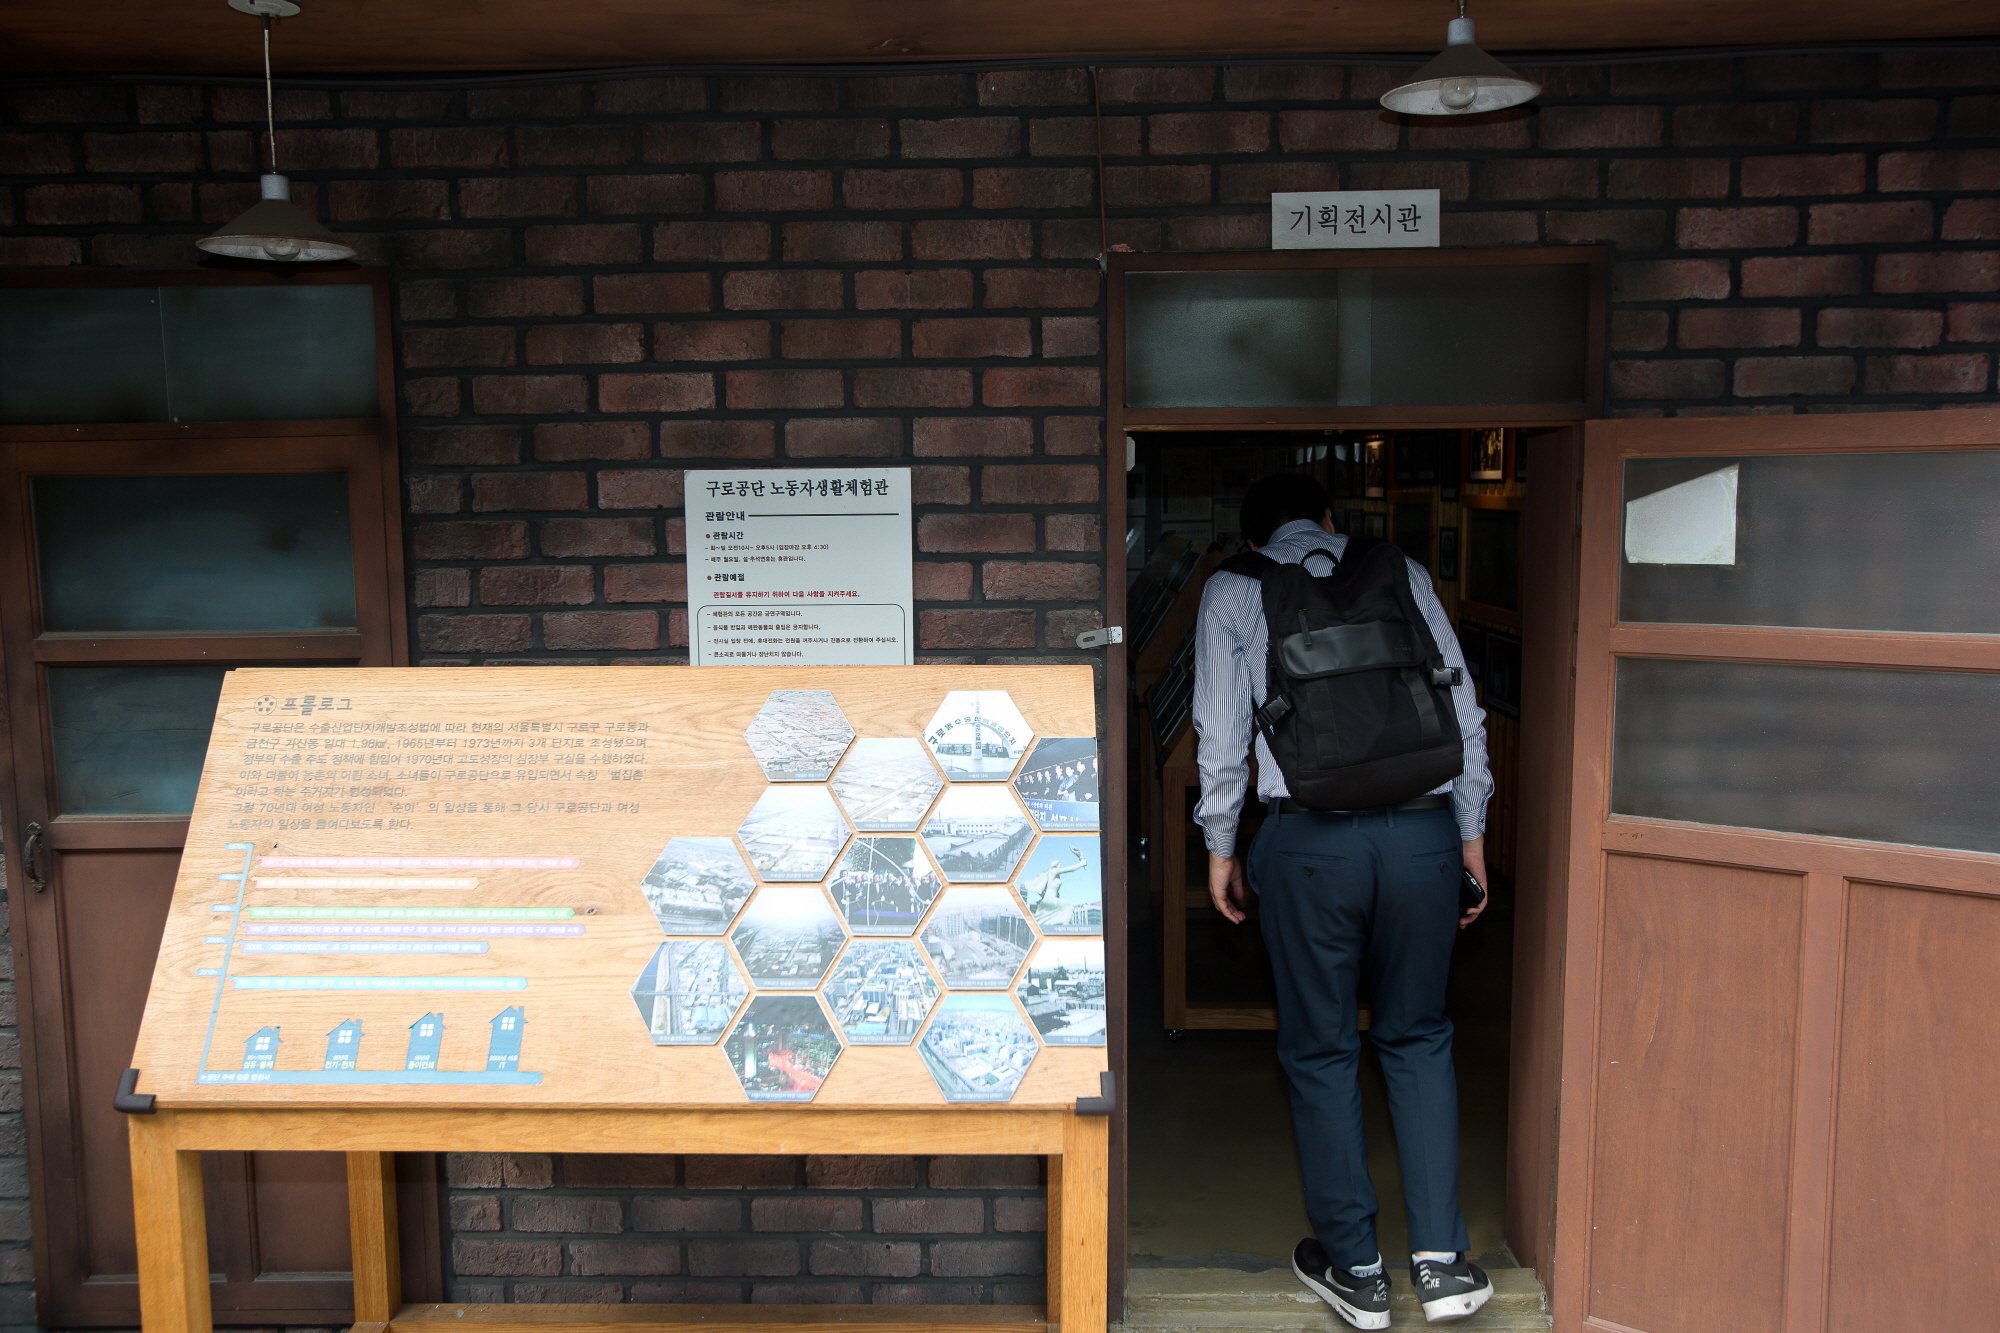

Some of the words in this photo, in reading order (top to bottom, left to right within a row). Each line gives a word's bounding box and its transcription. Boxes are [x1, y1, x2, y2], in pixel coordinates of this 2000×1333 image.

[1290, 204, 1422, 235] 기획전시관
[706, 480, 765, 497] 구로공단
[770, 478, 888, 497] 노동자생활체험관
[705, 511, 745, 521] 관람안내
[712, 532, 744, 540] 관람시간
[714, 573, 745, 581] 관람예절
[281, 695, 353, 716] 프롤로그
[250, 722, 305, 733] 구로공단은
[309, 722, 441, 733] 수출산업단지개발조성법에
[445, 722, 467, 733] 따라
[472, 722, 504, 733] 현재의
[508, 722, 563, 733] 서울특별시
[567, 722, 600, 733] 구로구
[604, 722, 649, 733] 구로동과
[246, 738, 281, 749] 금천구
[285, 738, 319, 749] 가산동
[324, 738, 346, 749] 일대
[397, 738, 457, 749] 1965년부터
[463, 738, 524, 749] 1973년까지
[529, 738, 547, 749] 3개
[552, 738, 585, 749] 단지로
[244, 754, 276, 765] 정부의
[280, 754, 302, 765] 수출
[306, 754, 327, 765] 주도
[332, 754, 364, 765] 정책에
[369, 754, 401, 765] 힘입어
[406, 754, 454, 765] 1970년대
[457, 754, 513, 765] 고도성장의
[516, 754, 549, 765] 심장부
[553, 754, 586, 765] 구실을
[590, 754, 648, 765] 수행하였다.
[240, 770, 262, 781] 이와
[266, 770, 299, 781] 더불어
[303, 770, 337, 781] 농촌의
[341, 770, 363, 781] 어린
[366, 770, 392, 781] 소녀,
[396, 770, 441, 781] 소녀들이
[445, 770, 512, 781] 구로공단으로
[516, 770, 572, 781] 유입되면서
[576, 770, 598, 781] 속칭
[274, 786, 296, 797] 하는
[300, 786, 345, 797] 주거지가
[349, 786, 408, 797] 형성되었다.
[260, 802, 297, 813] 70년대
[302, 802, 325, 813] 여성
[328, 802, 375, 813] 노동자인
[428, 802, 439, 813] 의
[444, 802, 478, 813] 일상을
[483, 802, 506, 813] 통해
[510, 804, 523, 812] 그
[527, 802, 550, 813] 당시
[554, 802, 612, 813] 구로공단과
[618, 802, 640, 813] 여성
[227, 819, 274, 830] 노동자의
[278, 819, 312, 830] 일상을
[316, 819, 384, 830] 들여다보도록
[388, 819, 413, 830] 한다.
